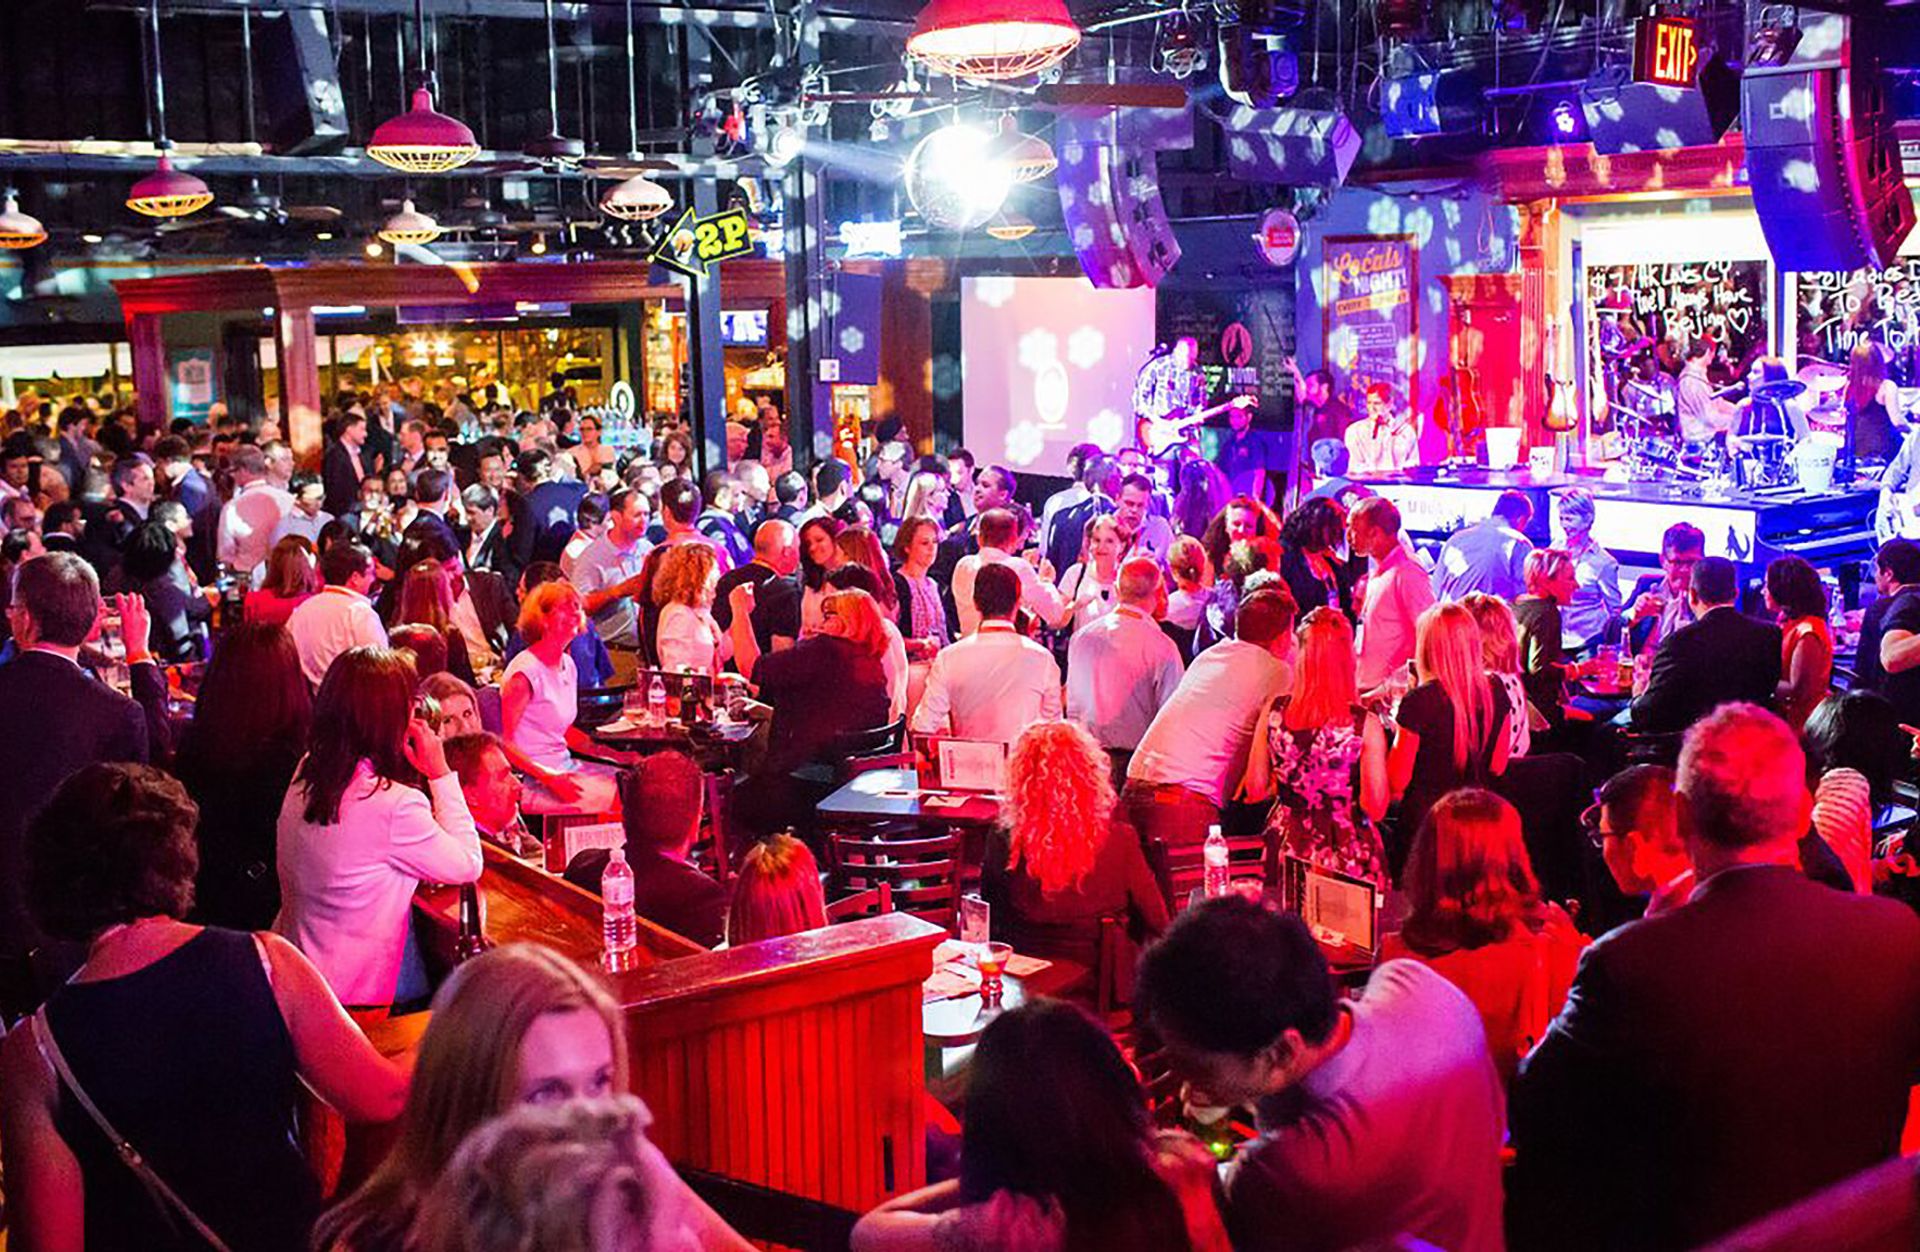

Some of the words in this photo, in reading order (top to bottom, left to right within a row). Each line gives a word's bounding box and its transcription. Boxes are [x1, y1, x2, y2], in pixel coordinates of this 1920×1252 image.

[1655, 24, 1693, 81] EXIT
[695, 215, 746, 259] 2P
[1714, 283, 1754, 306] Have
[1829, 286, 1861, 315] To
[1663, 308, 1727, 342] Beijing
[1813, 316, 1872, 354] Time
